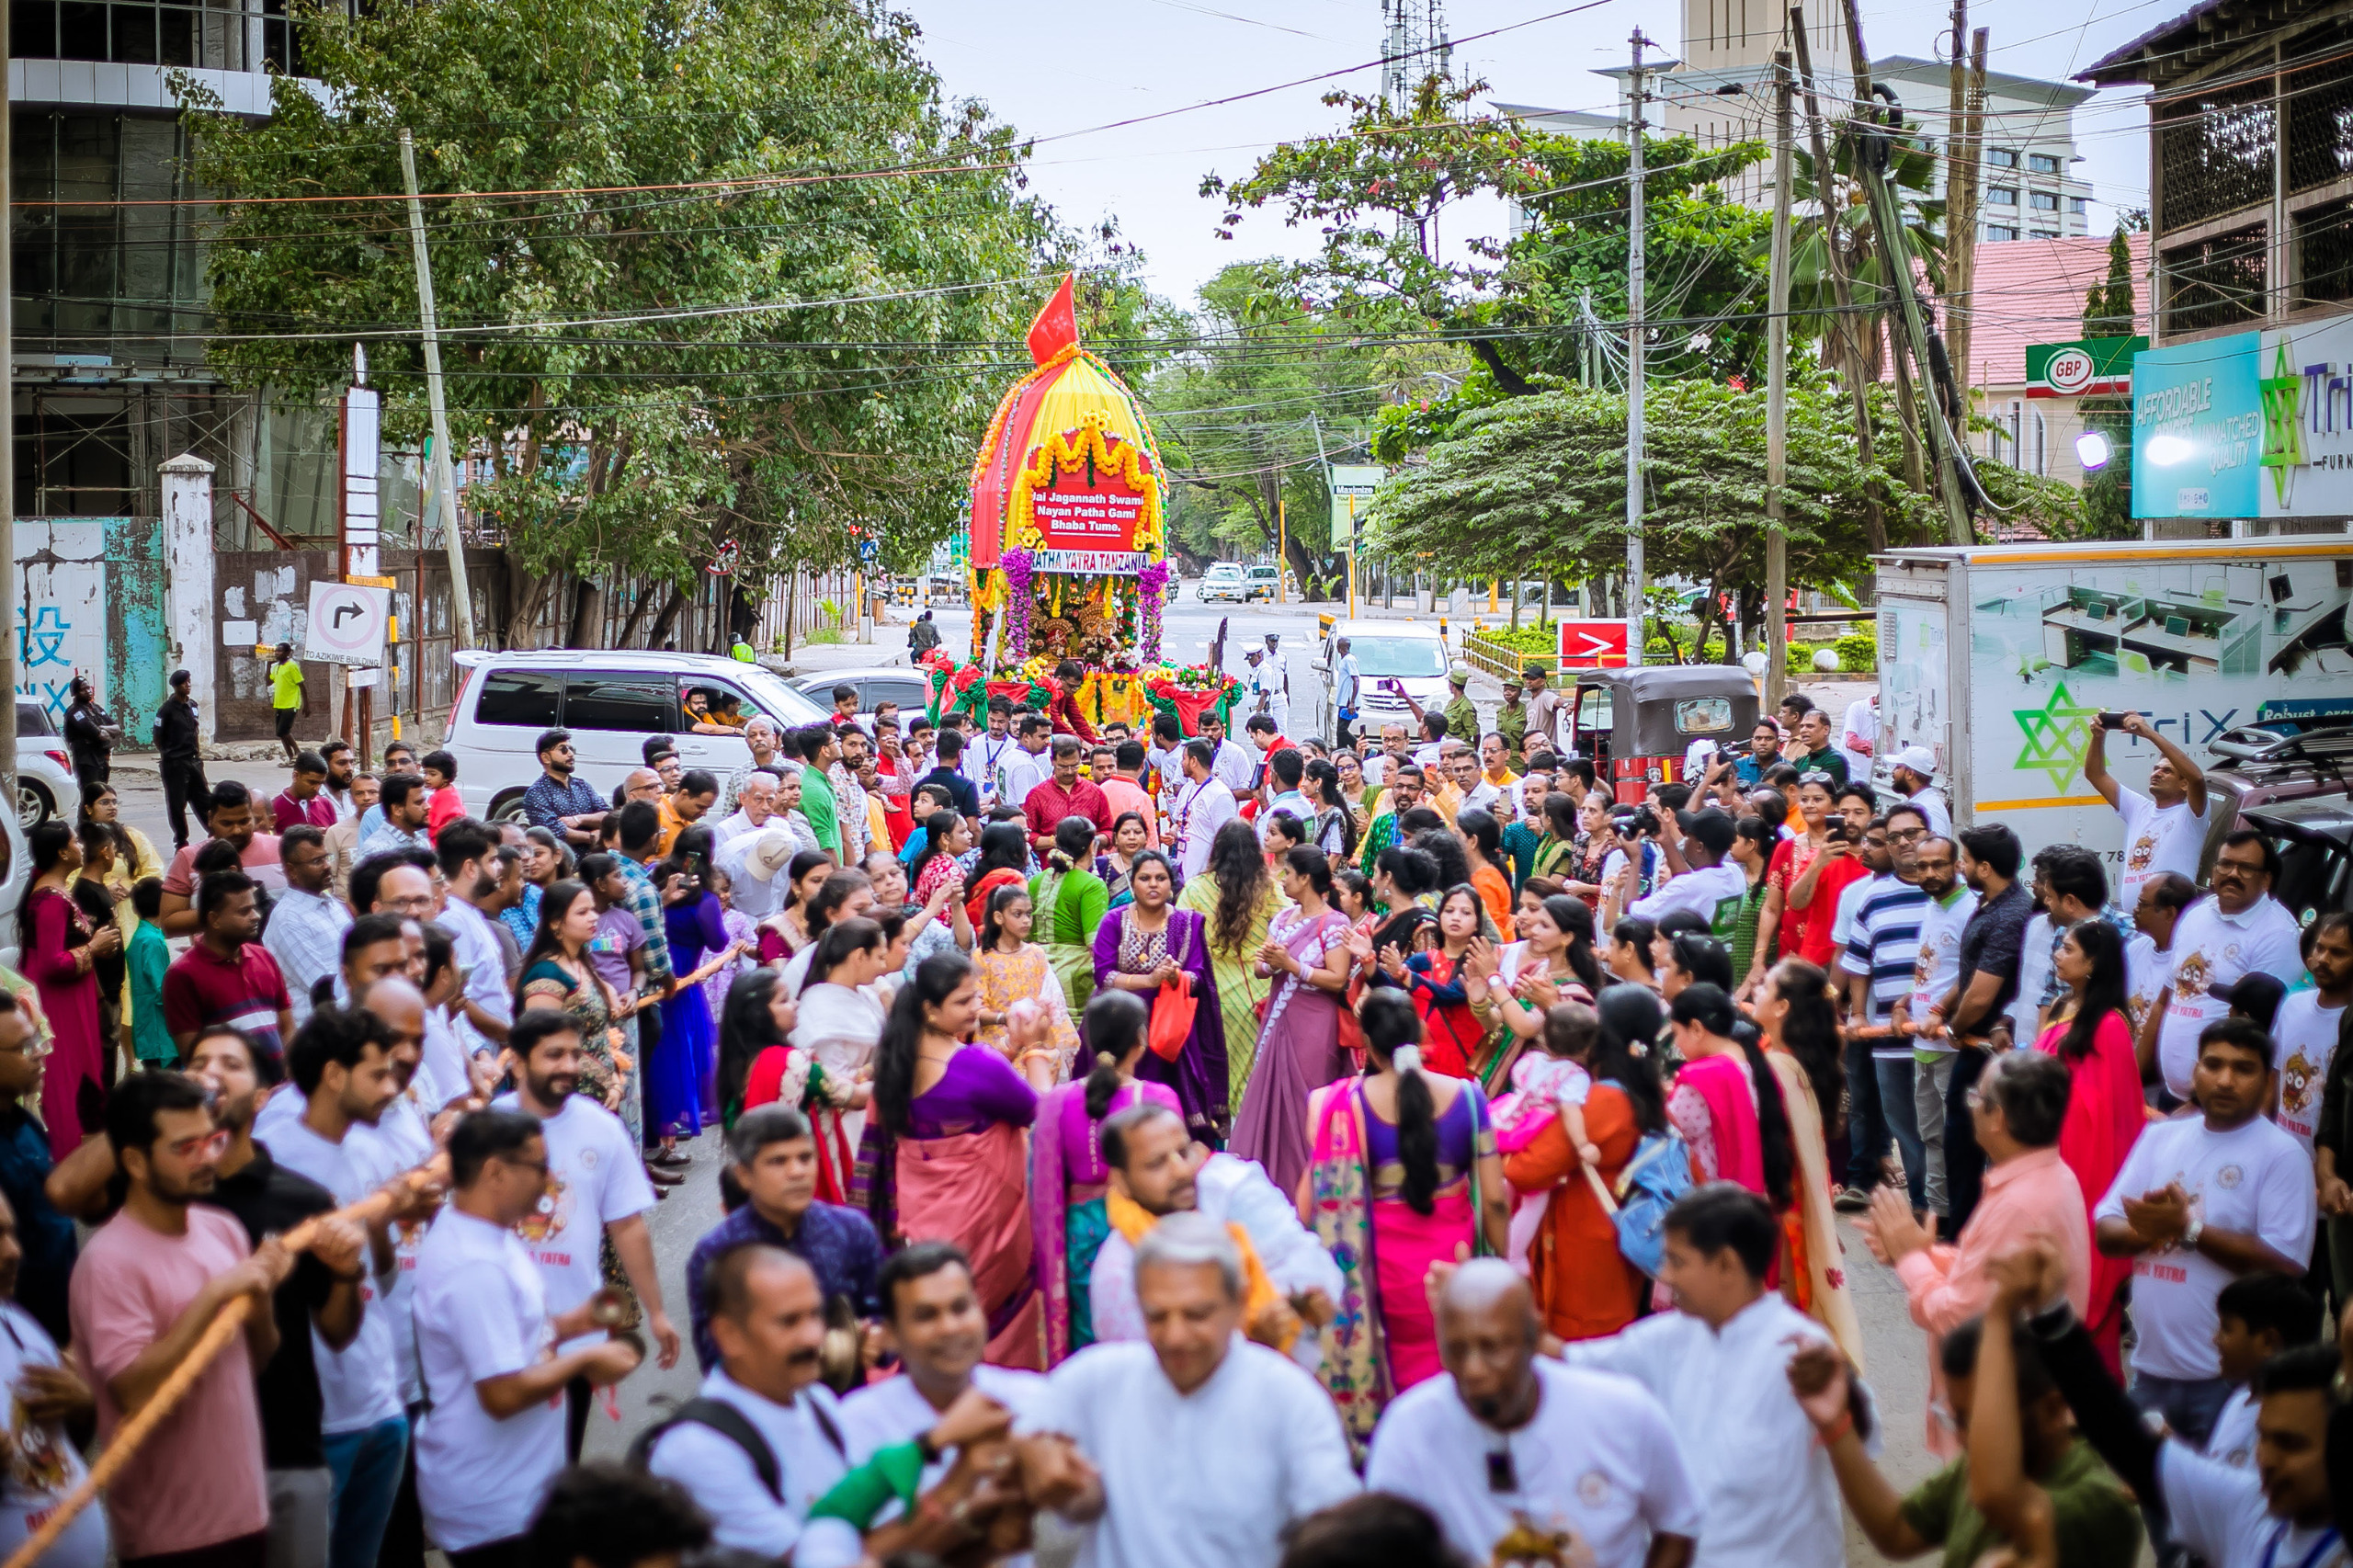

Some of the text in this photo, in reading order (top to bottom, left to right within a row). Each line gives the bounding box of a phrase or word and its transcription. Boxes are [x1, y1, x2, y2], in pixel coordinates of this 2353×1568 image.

[2056, 360, 2082, 378] GBP
[2135, 377, 2212, 427] AFFORDABLE
[2210, 440, 2251, 477] QUALITY
[1336, 485, 1374, 494] Maximize
[1032, 492, 1144, 505] Jai Jagannath Swami
[1037, 505, 1136, 518] Nayan Patha Gami
[1051, 519, 1121, 531] Bhaba Tume.
[1030, 551, 1148, 572] RATHA YATRA TANZANIA
[305, 650, 379, 667] TO AZIKIWE BUILDING
